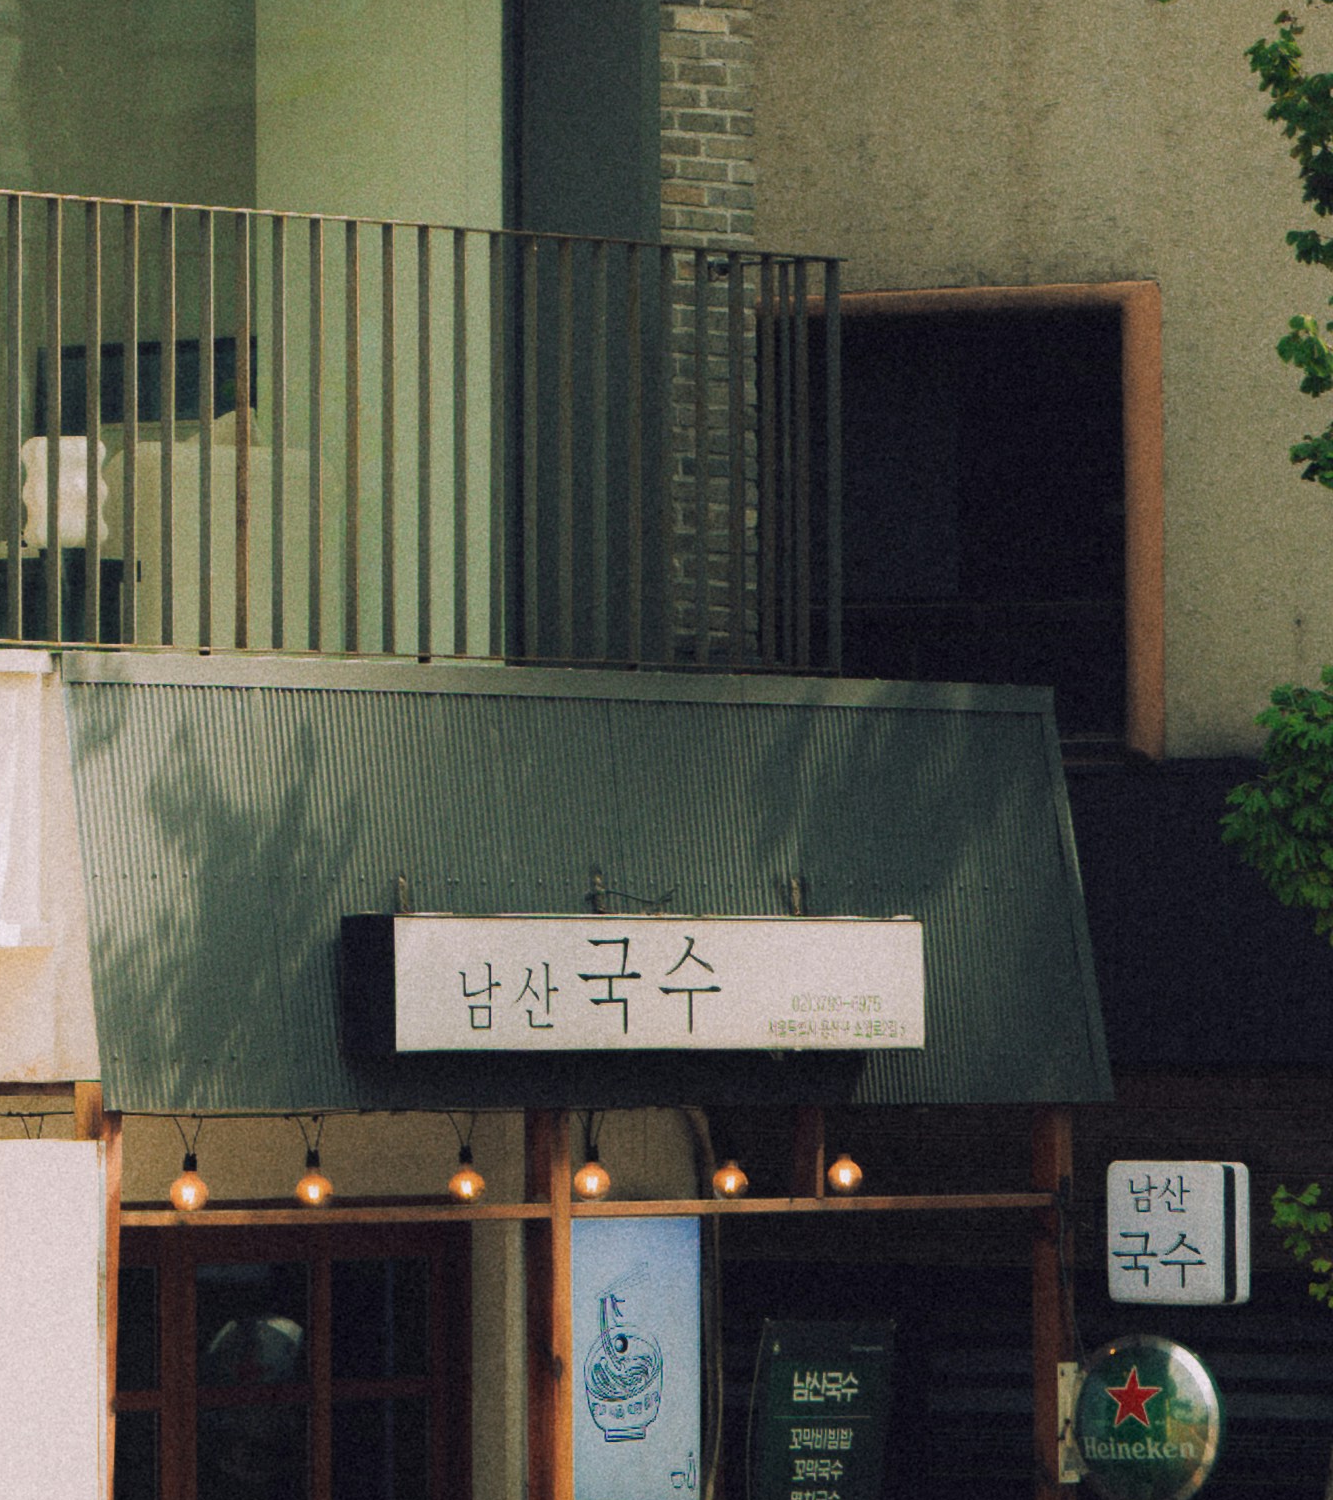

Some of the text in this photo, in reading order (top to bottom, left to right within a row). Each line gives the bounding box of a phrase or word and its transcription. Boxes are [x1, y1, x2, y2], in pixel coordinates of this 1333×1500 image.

[1128, 1174, 1191, 1214] 남산
[1111, 1231, 1207, 1289] 국수
[792, 1370, 860, 1403] 남산국수
[1084, 1436, 1196, 1461] Heineken
[791, 1459, 844, 1482] 꼬막국수
